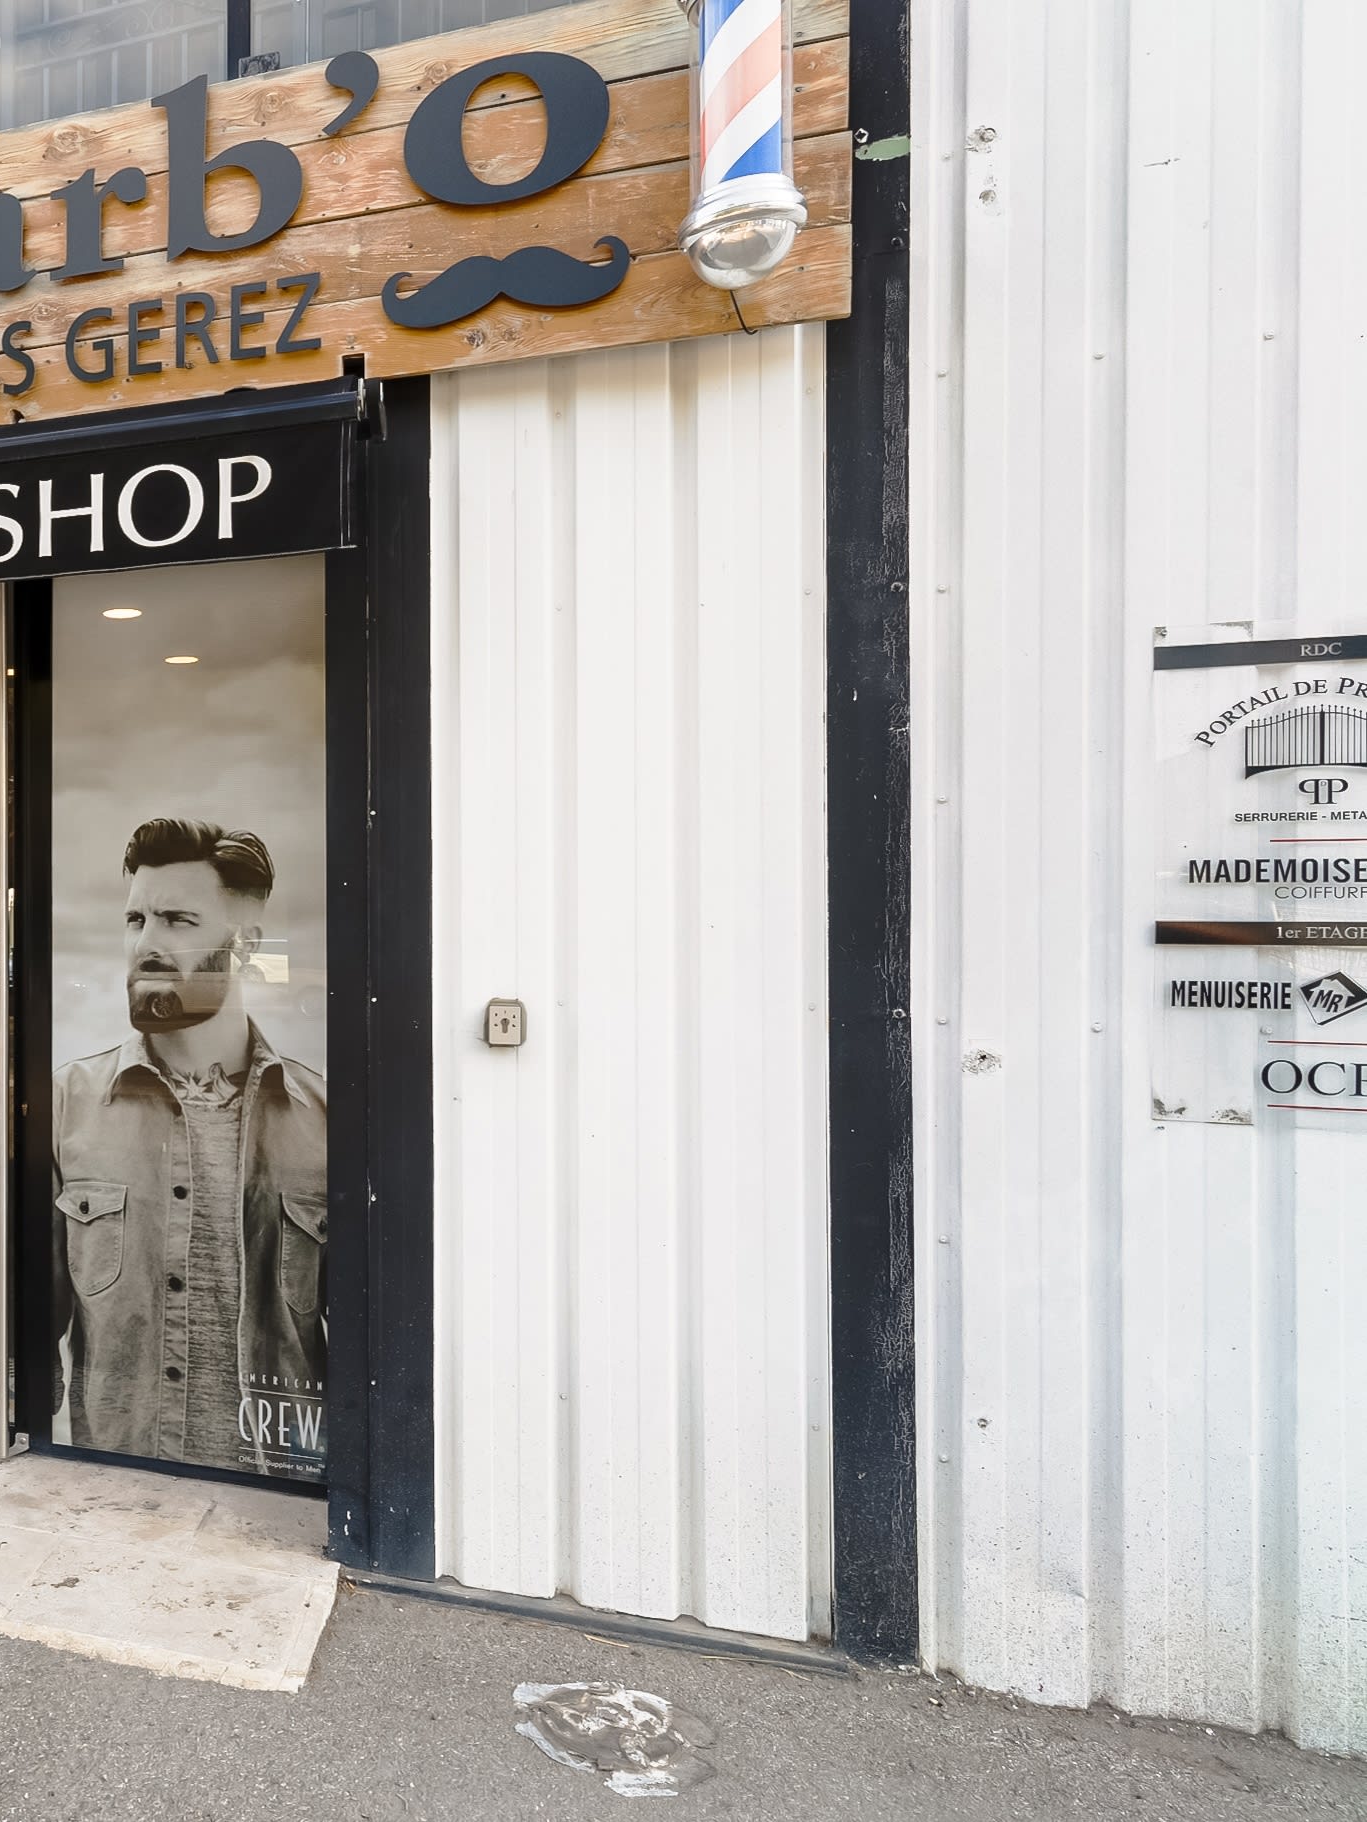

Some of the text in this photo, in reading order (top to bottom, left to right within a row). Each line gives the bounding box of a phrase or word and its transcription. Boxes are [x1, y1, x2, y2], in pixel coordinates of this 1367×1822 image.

[66, 272, 321, 383] GEREZ
[1300, 642, 1342, 657] RDC
[1194, 686, 1288, 747] PORTAIL
[1293, 679, 1328, 696] DE
[1234, 811, 1318, 822] SERRURERIE
[1189, 858, 1367, 884] MADEMOISE
[1276, 924, 1367, 940] 1er ETAGE
[1171, 980, 1344, 1013] MENUISERIE MR
[240, 1372, 323, 1391] MERICAN
[238, 1397, 323, 1451] CREW
[265, 1458, 294, 1469] Supplier
